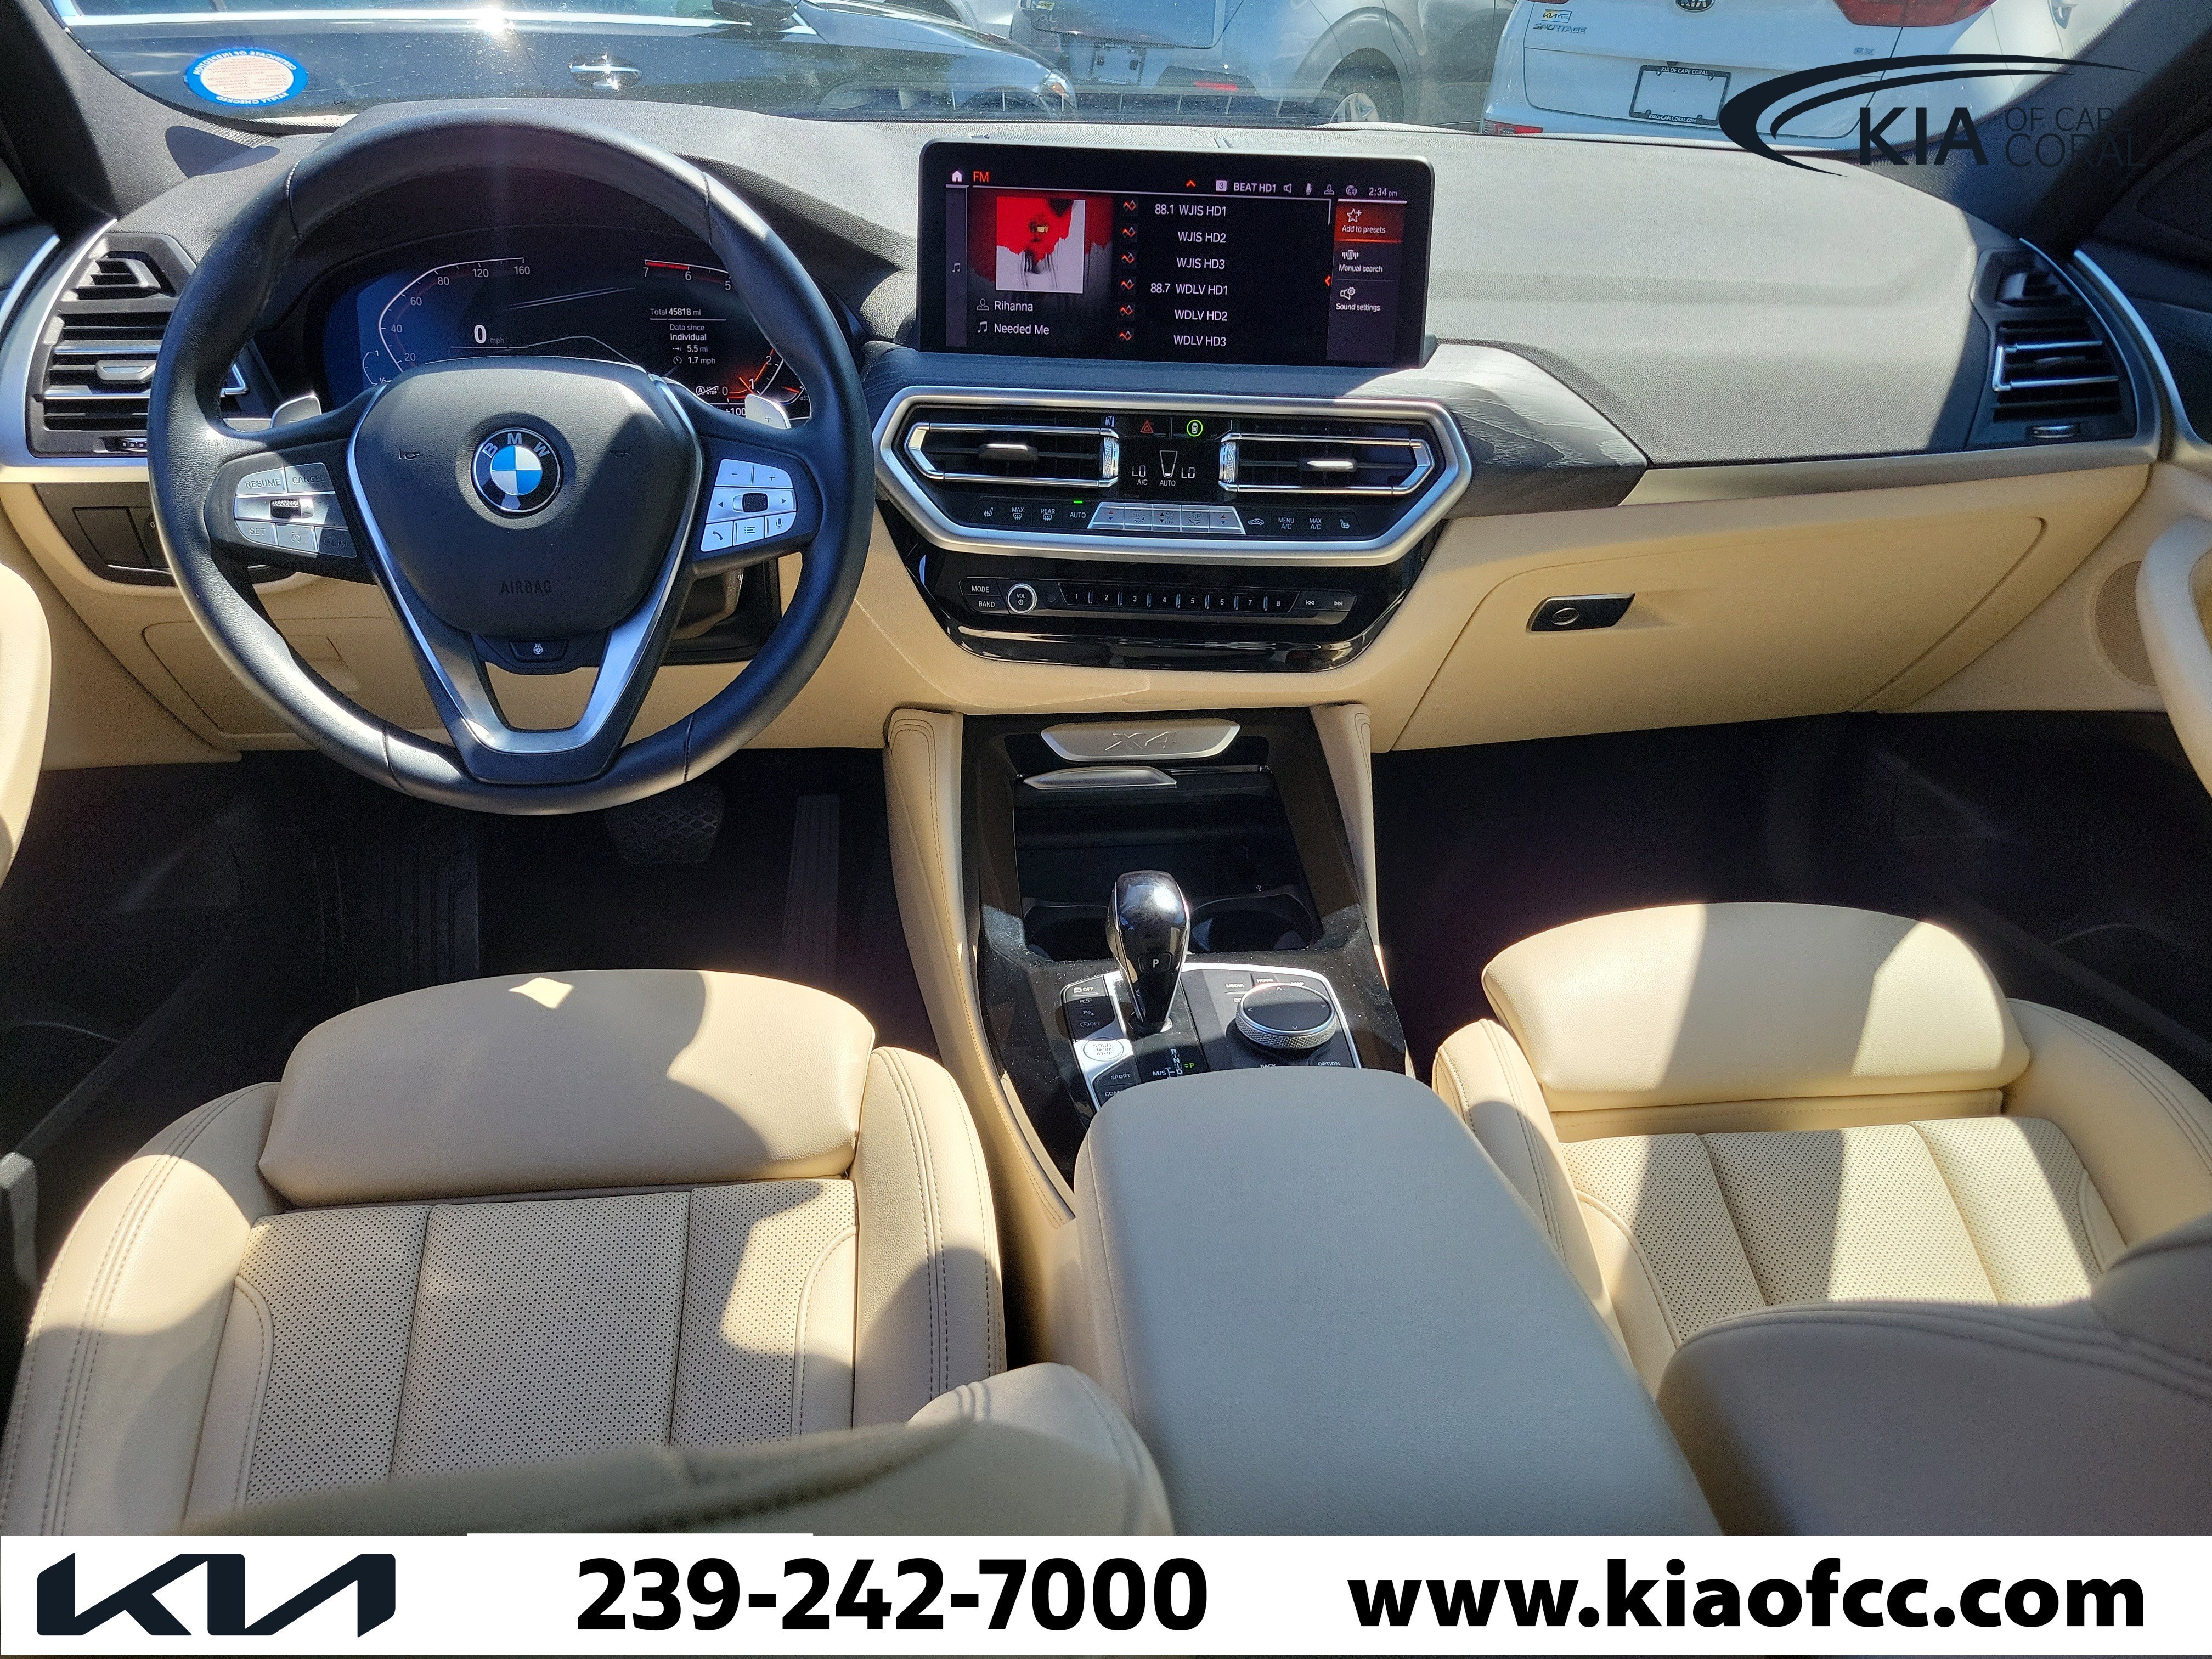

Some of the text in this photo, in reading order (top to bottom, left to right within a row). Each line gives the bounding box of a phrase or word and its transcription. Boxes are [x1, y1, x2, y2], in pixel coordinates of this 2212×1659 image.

[1532, 23, 1587, 34] SPORTAGE
[973, 171, 989, 182] FM
[1234, 182, 1257, 192] BEAT
[1259, 183, 1276, 193] HD1
[1369, 187, 1387, 196] 2:34
[1155, 204, 1226, 216] 88.1 WJIS HD1
[1363, 226, 1386, 234] presets
[1178, 231, 1226, 243] WJIS HD2
[1177, 257, 1225, 269] WJIS HD3
[472, 269, 489, 278] 120
[514, 266, 530, 275] 160
[643, 267, 648, 277] 7
[438, 276, 449, 285] 80
[685, 271, 691, 281] 6
[725, 281, 731, 290] 5
[1150, 283, 1228, 295] 88.7 WDLV HD1
[411, 297, 422, 306] 60
[994, 301, 1033, 311] Rihanna
[1357, 303, 1381, 312] settings
[1175, 309, 1227, 321] WDLV HD2
[391, 324, 402, 333] 40
[994, 323, 1049, 335] Needed Me
[473, 325, 487, 343] 0
[1173, 335, 1226, 346] WDLV HD3
[404, 353, 416, 362] 20
[701, 357, 716, 365] mph
[766, 356, 772, 365] 2
[749, 378, 754, 390] 1
[721, 386, 728, 396] 0
[482, 433, 550, 458] BMW
[1132, 465, 1146, 477] LO
[1181, 467, 1195, 478] LO
[245, 478, 281, 489] RESUME
[292, 476, 325, 484] CANCEL
[249, 527, 266, 536] SET
[500, 580, 552, 595] AIRBAG
[1105, 731, 1176, 751] X4
[1153, 958, 1160, 968] P
